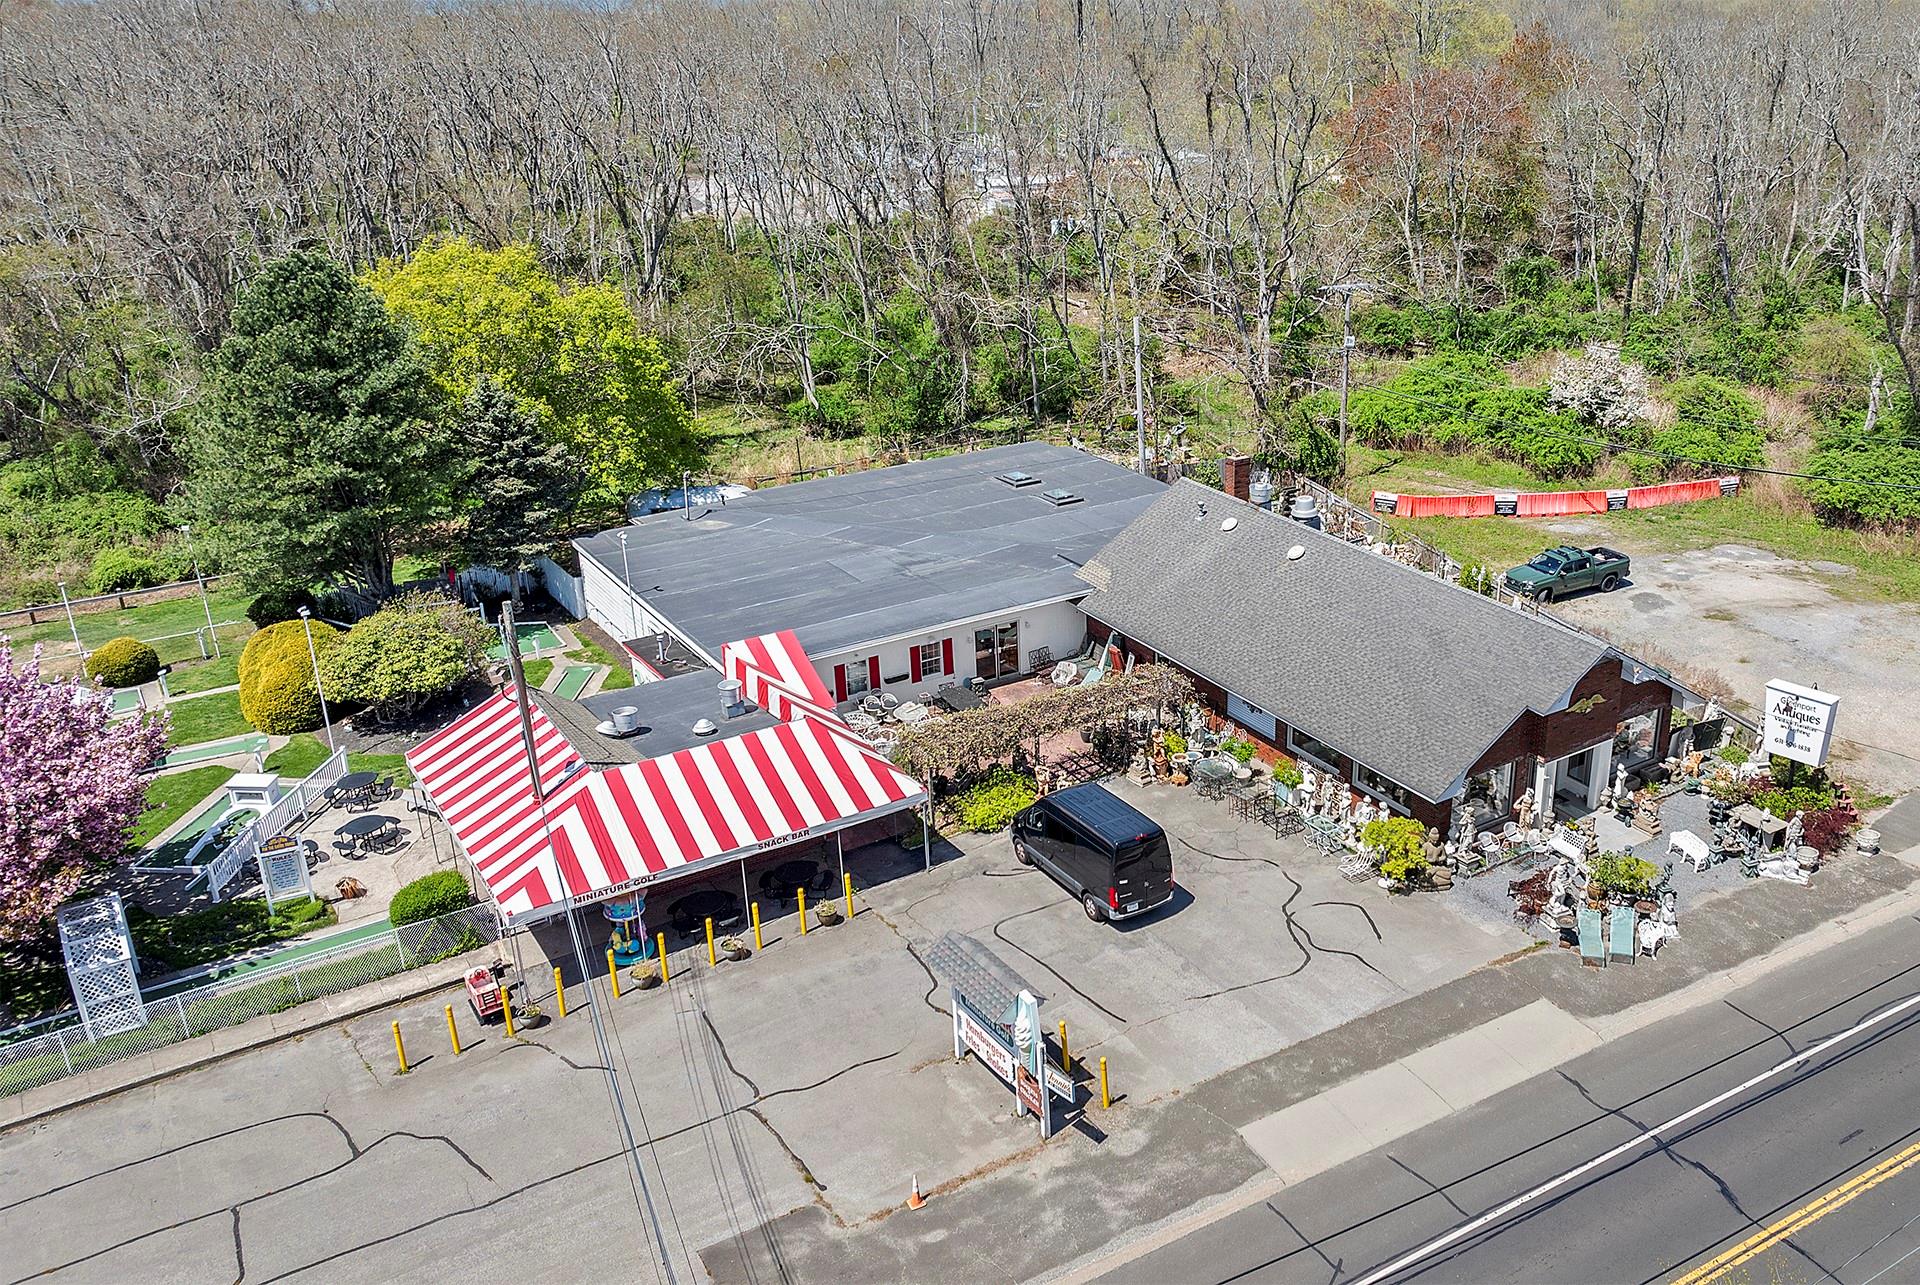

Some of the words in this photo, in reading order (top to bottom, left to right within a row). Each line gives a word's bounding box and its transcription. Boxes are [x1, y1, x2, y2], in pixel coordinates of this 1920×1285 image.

[1773, 702, 1821, 725] Antiques
[758, 836, 789, 850] SNACK
[791, 830, 810, 840] BAR
[271, 854, 292, 862] RULES
[573, 882, 631, 905] MINIATURE
[634, 874, 659, 886] GOLF
[965, 1017, 1006, 1063] Hamburgers
[965, 1031, 980, 1052] Fries
[995, 1025, 1010, 1042] Golf
